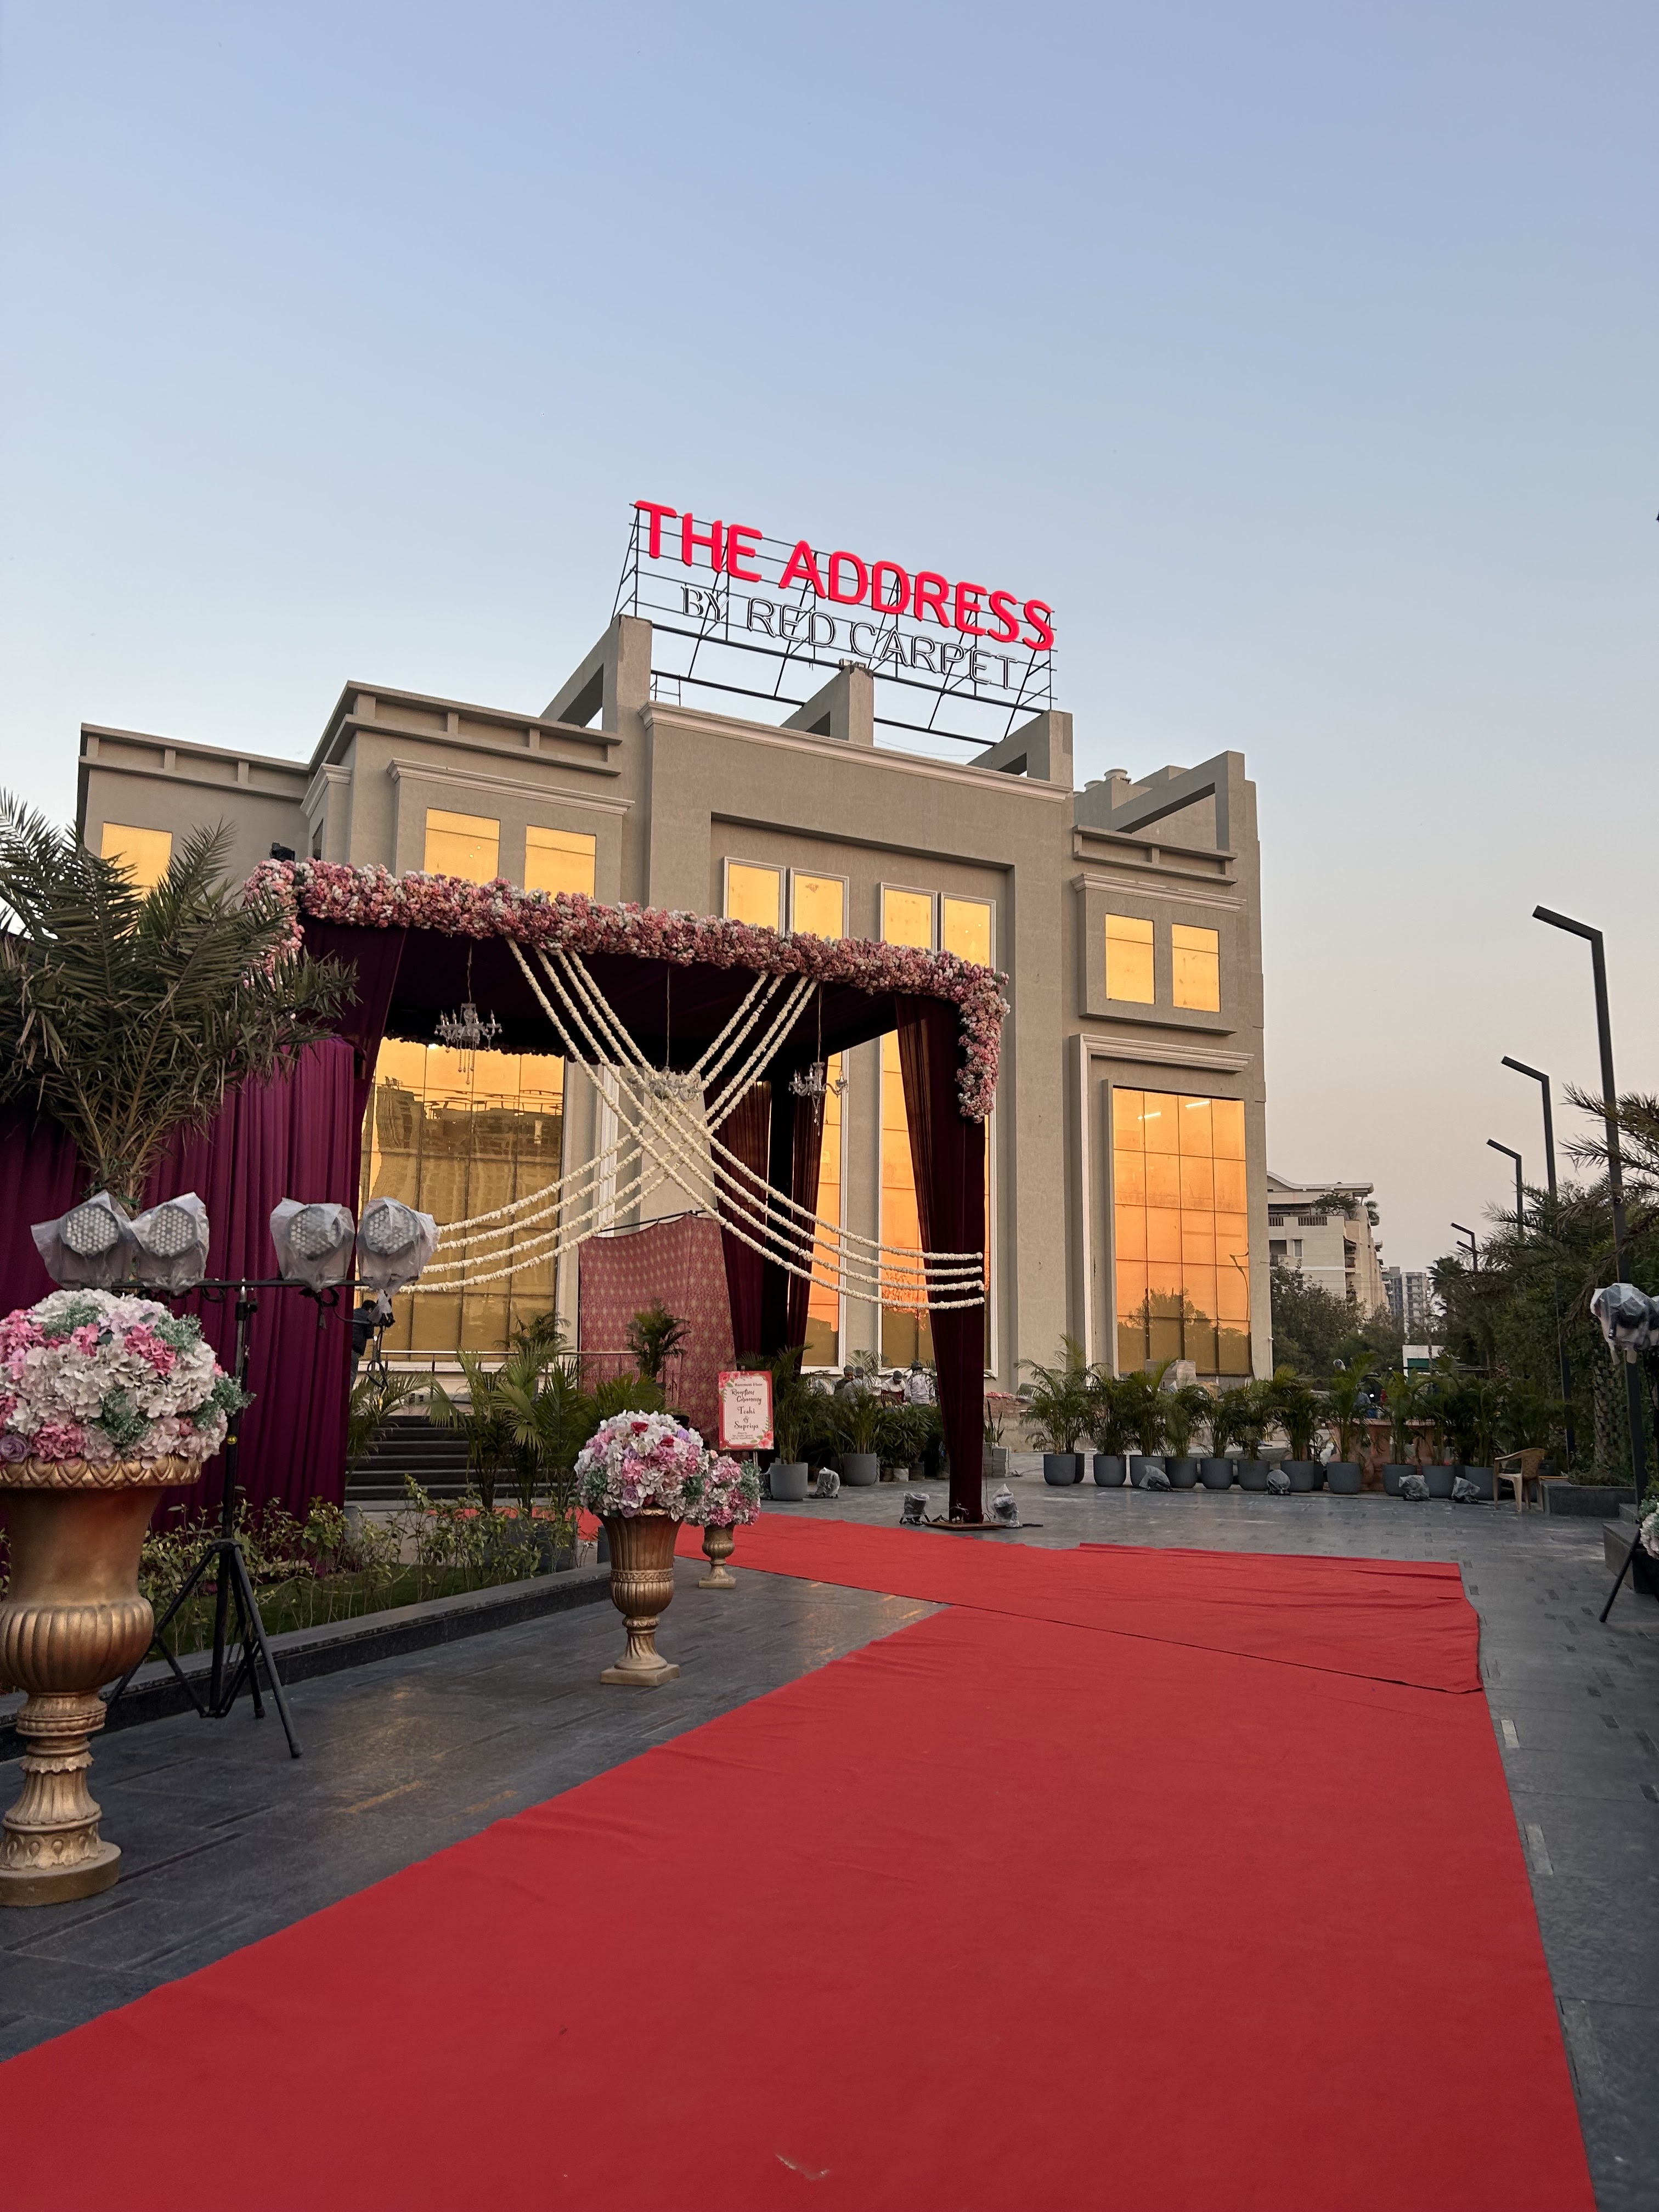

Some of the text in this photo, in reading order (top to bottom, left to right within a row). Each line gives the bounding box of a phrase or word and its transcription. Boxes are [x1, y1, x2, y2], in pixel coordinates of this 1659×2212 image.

[634, 500, 1054, 650] THE ADDRESS
[681, 584, 1018, 689] BY RED CARPET
[733, 1421, 759, 1431] Supriya
[743, 1415, 749, 1424] &
